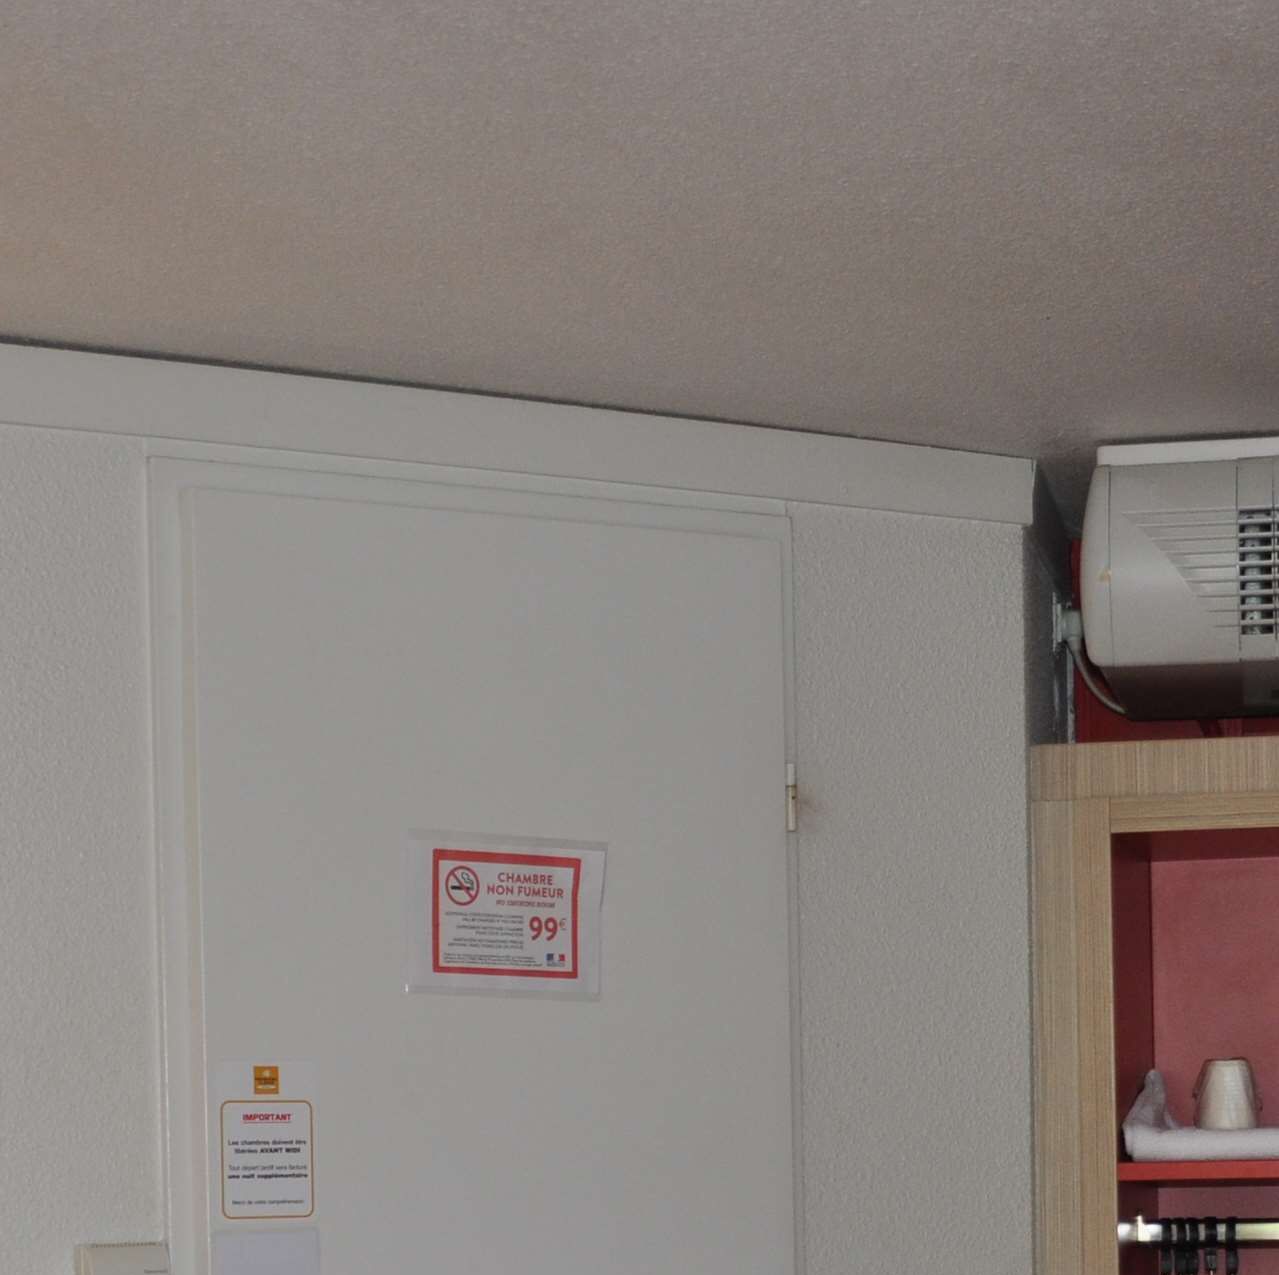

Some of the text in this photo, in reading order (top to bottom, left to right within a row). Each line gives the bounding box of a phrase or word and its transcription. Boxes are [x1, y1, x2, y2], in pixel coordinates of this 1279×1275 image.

[497, 871, 554, 886] CHAMBRE
[486, 884, 565, 899] NON FUMEUR
[242, 1113, 292, 1122] IMPORTANT
